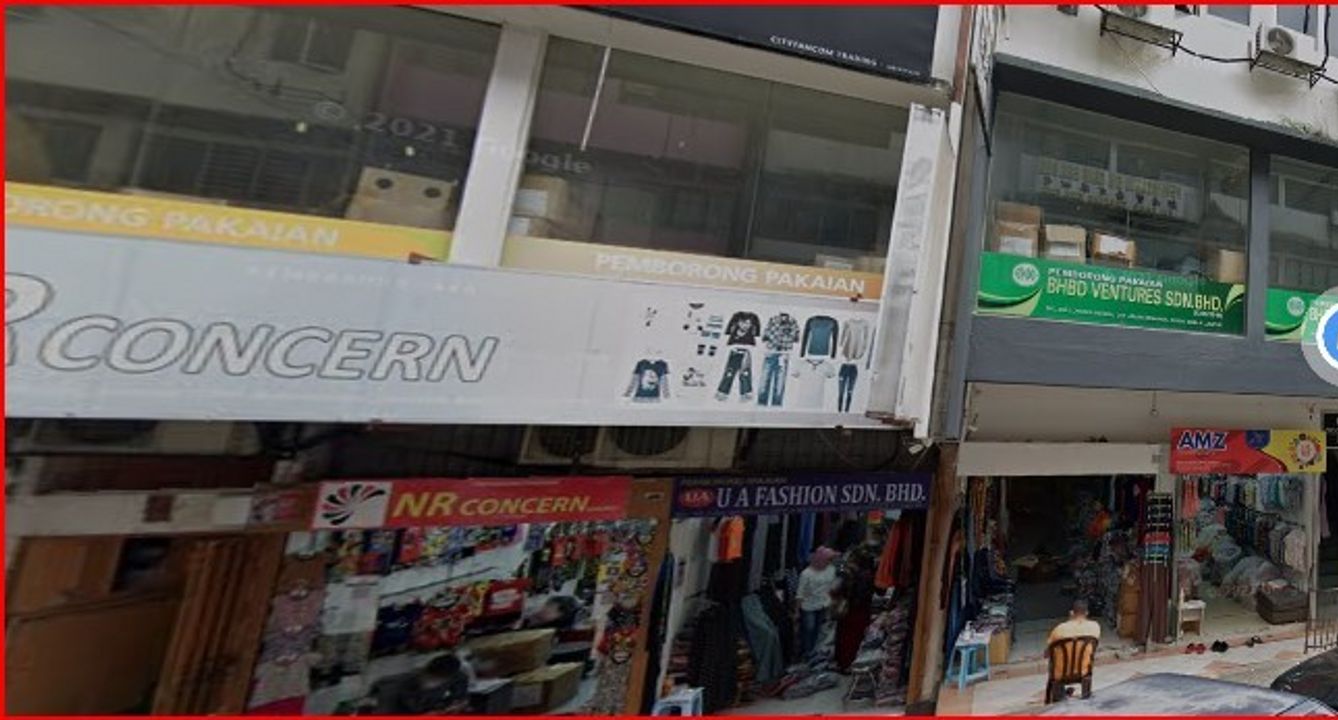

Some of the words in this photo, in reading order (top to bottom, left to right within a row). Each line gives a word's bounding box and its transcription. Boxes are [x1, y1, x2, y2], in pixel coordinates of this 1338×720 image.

[162, 209, 339, 247] PAKAIAN
[594, 252, 758, 284] PEMBORONG
[764, 269, 866, 293] PAKAIAN
[1047, 276, 1087, 297] BHBD
[1090, 281, 1162, 305] VENTURES
[38, 314, 499, 384] CONCERN
[1177, 431, 1228, 451] AMZ
[393, 492, 458, 517] NR
[459, 497, 590, 515] CONCERN
[717, 487, 732, 508] U
[735, 487, 750, 507] A
[754, 484, 837, 507] FASHION
[841, 483, 881, 503] SDN.
[886, 483, 926, 502] BHD.
